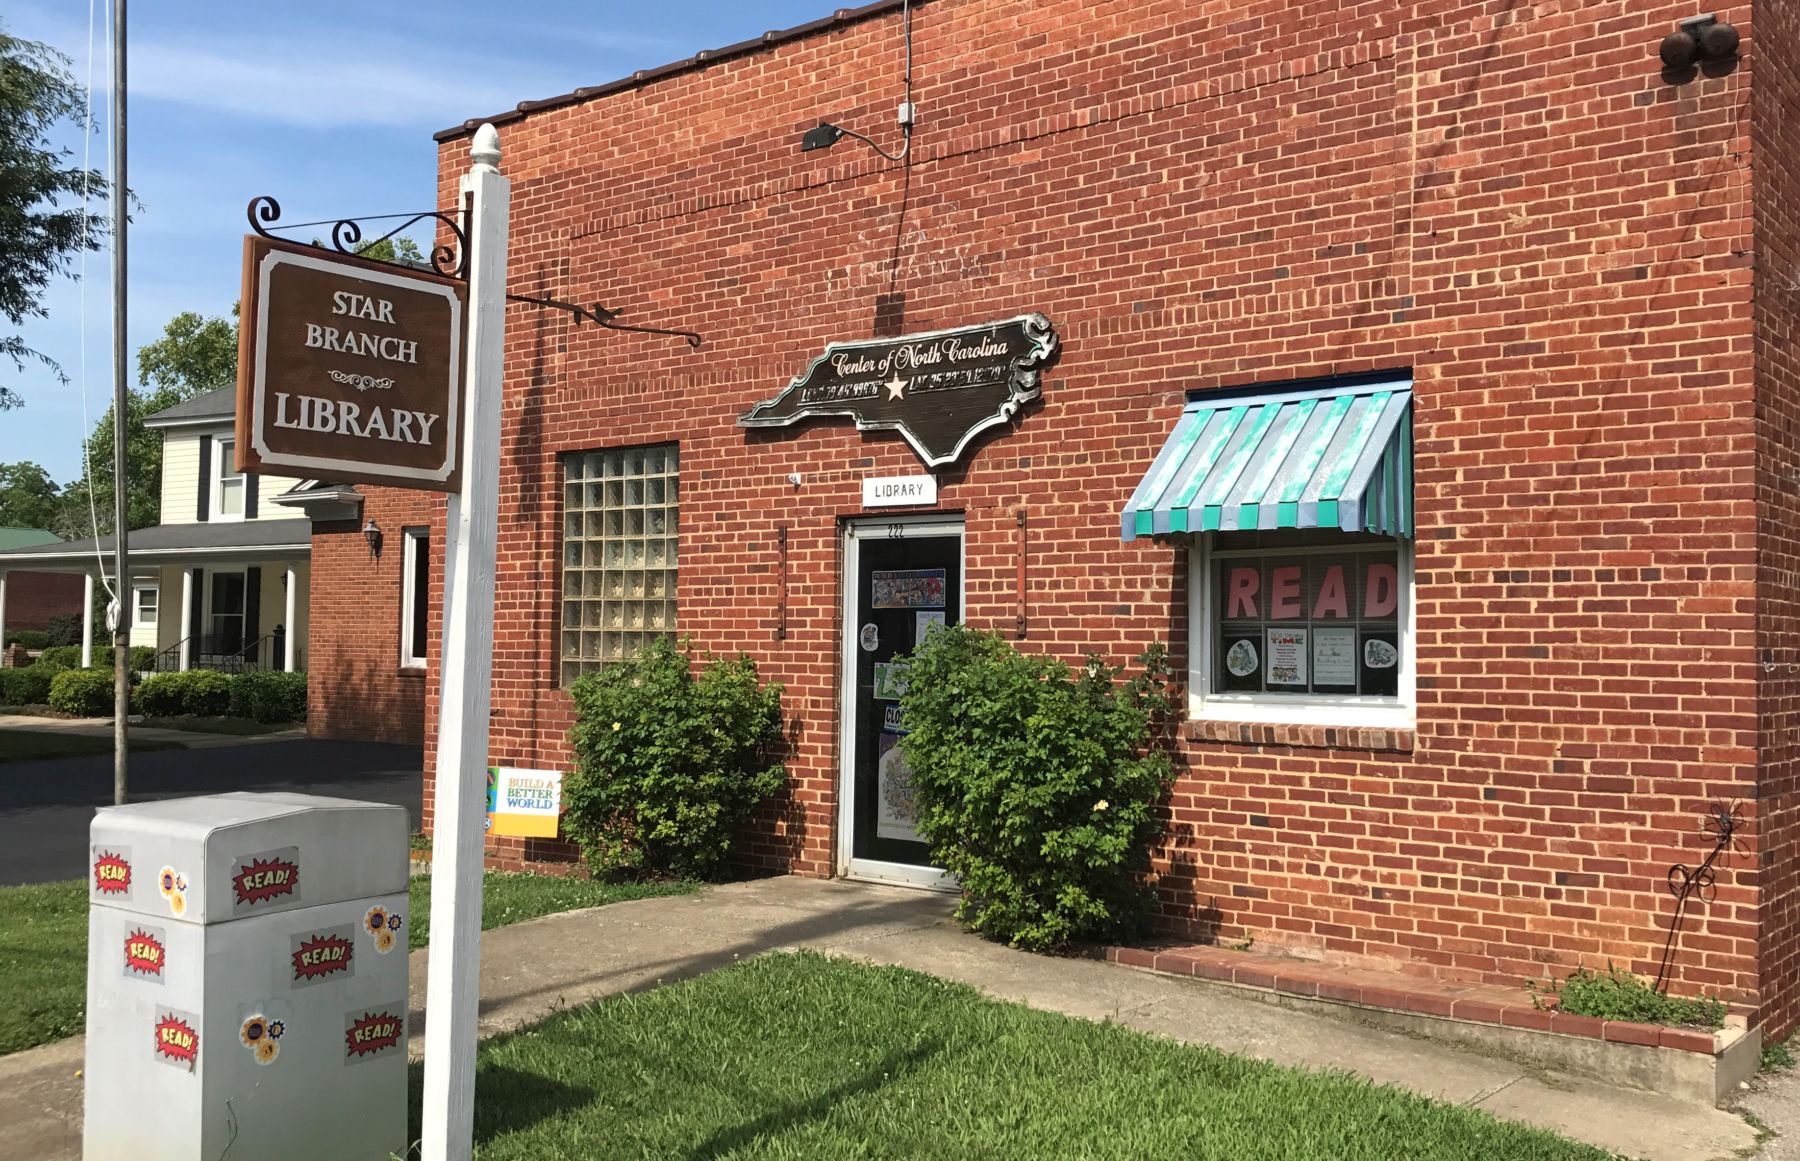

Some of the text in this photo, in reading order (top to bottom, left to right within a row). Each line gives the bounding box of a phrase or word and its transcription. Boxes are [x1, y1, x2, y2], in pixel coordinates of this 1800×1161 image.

[332, 290, 396, 324] STAR
[304, 323, 418, 364] BRANCH
[831, 336, 1009, 378] Center of North Carolina
[273, 391, 440, 445] LIBRARY
[874, 483, 924, 498] LIBRARY
[888, 524, 904, 538] 222
[1228, 563, 1398, 619] READ
[507, 788, 553, 799] BETTER
[508, 777, 554, 789] BUILD A
[507, 798, 553, 809] WORLD
[99, 864, 127, 882] READ!
[242, 870, 291, 890] READ!
[130, 942, 160, 965] READ!
[301, 946, 345, 967] READ!
[161, 1027, 193, 1050] READ!
[354, 1023, 396, 1044] READ!
